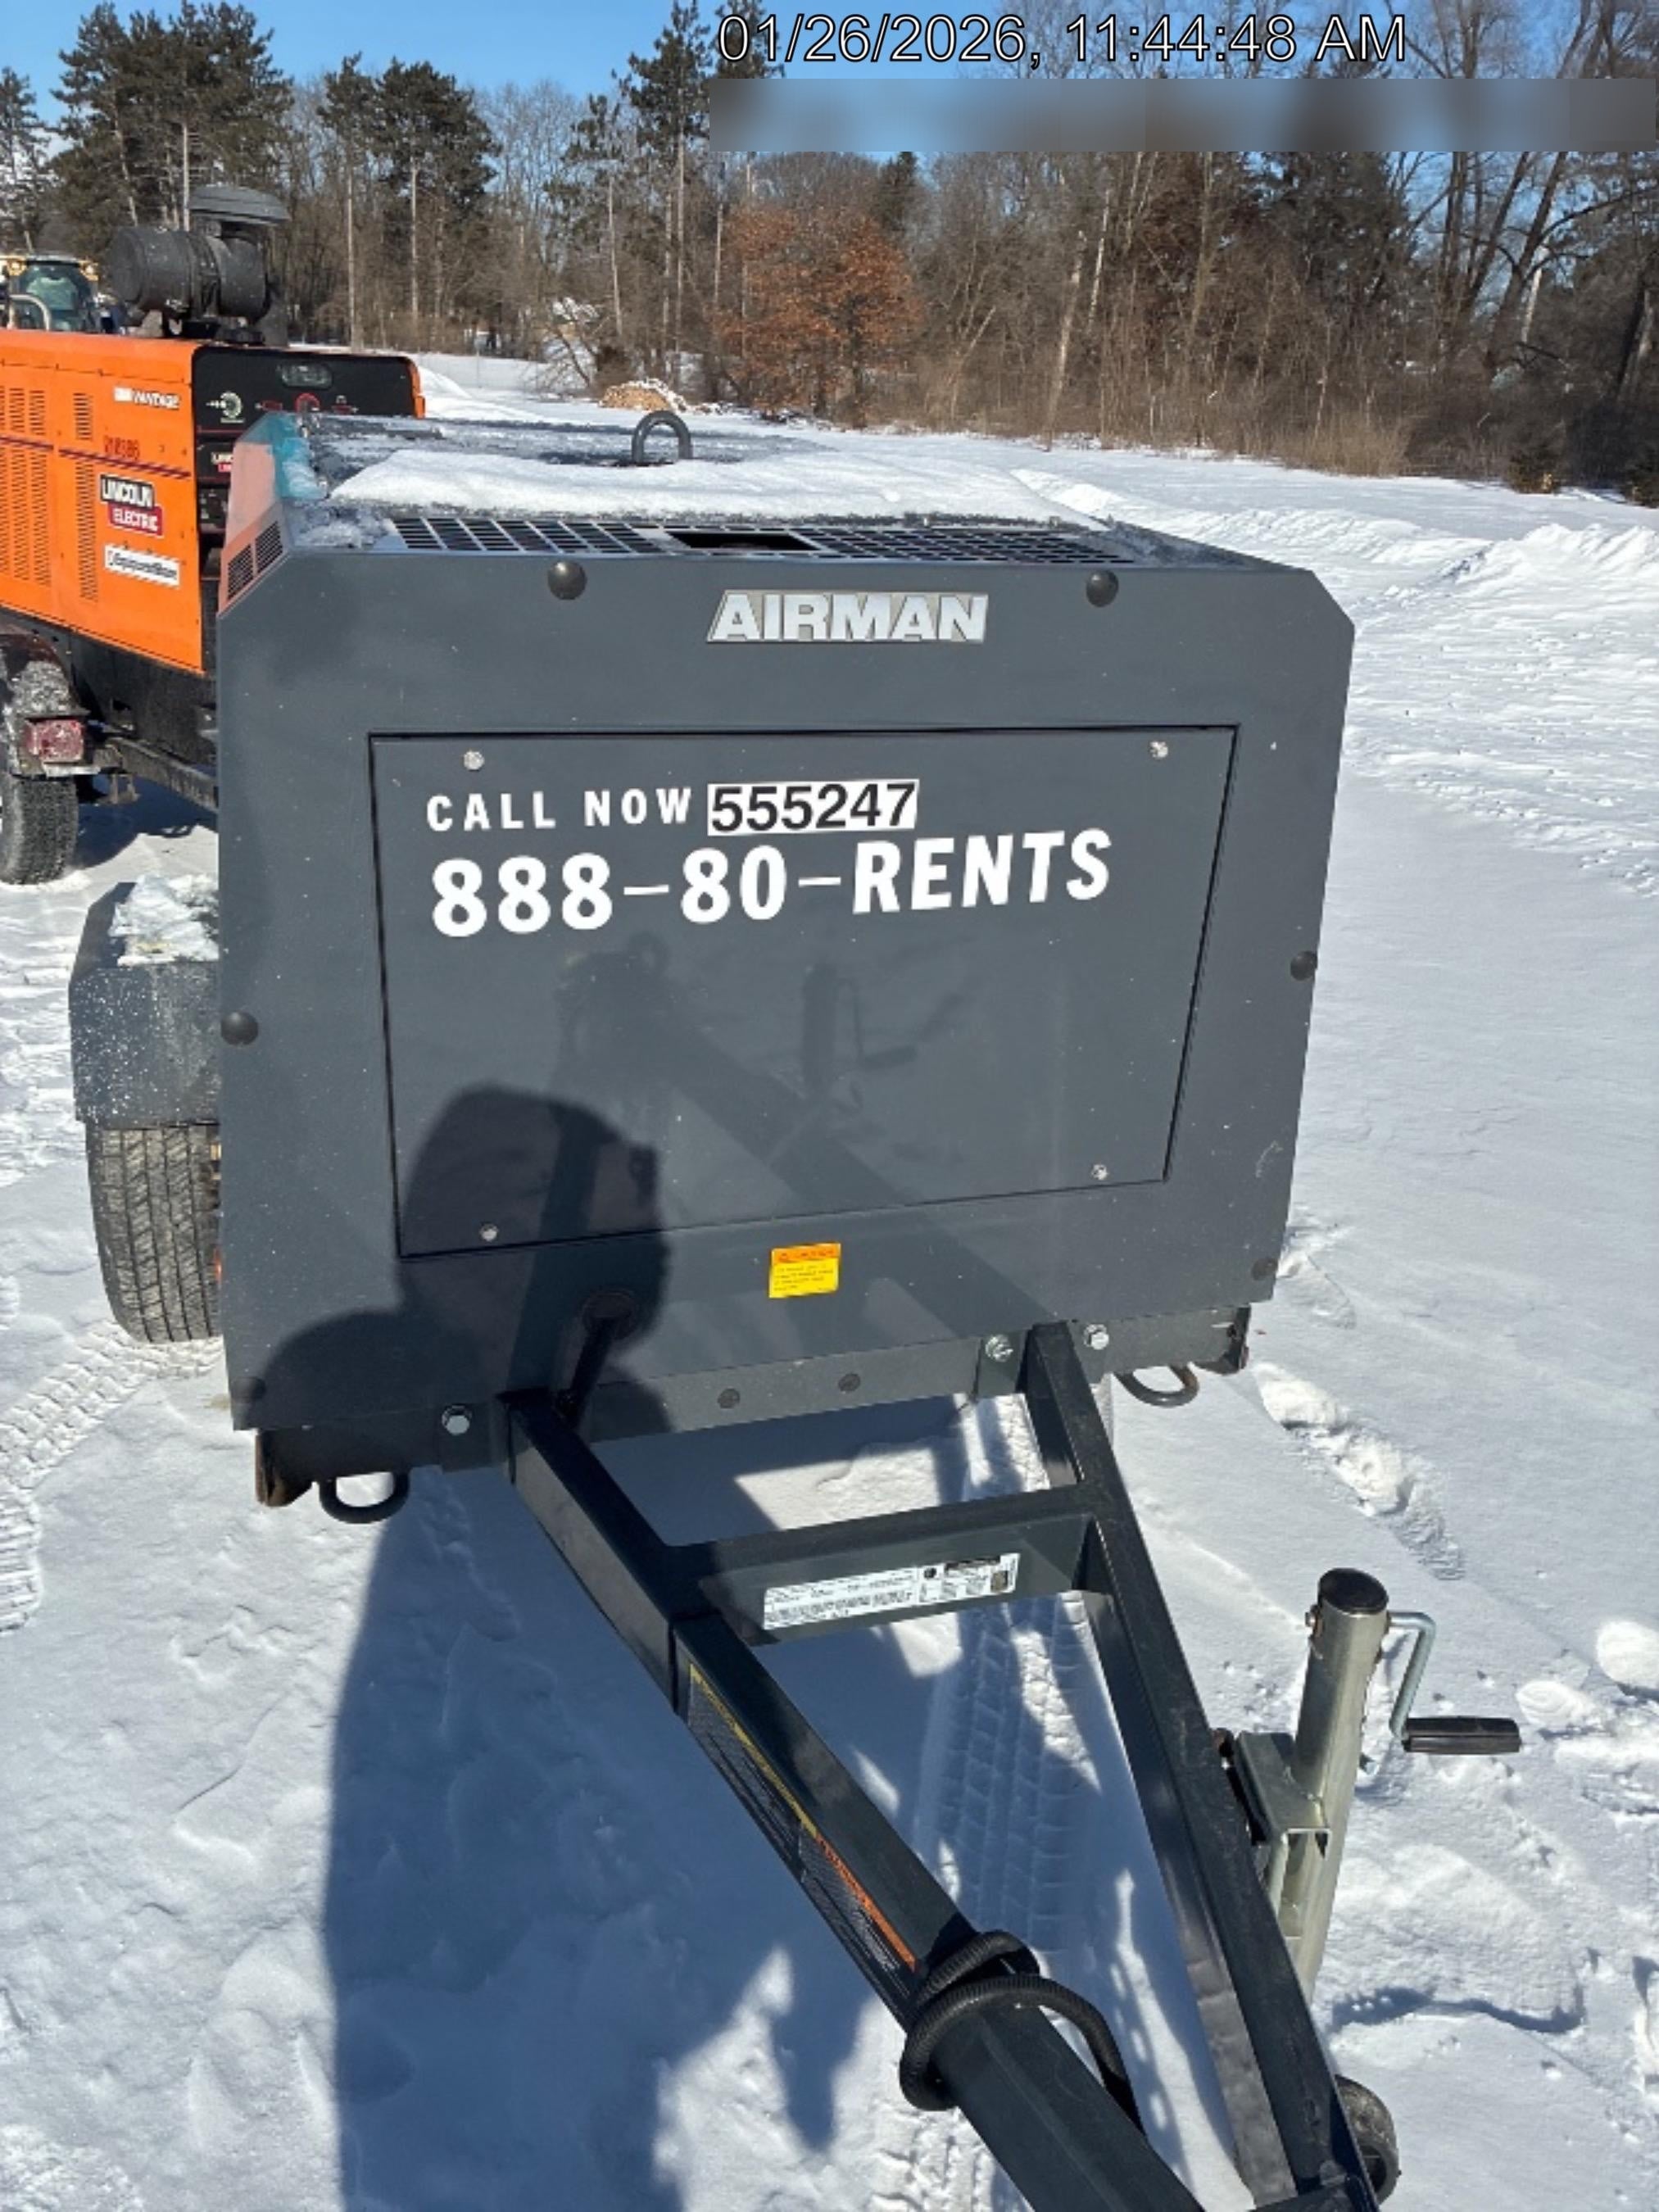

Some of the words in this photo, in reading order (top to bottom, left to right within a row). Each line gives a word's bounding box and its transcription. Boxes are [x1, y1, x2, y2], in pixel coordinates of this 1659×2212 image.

[102, 478, 154, 508] LINCOLN
[112, 508, 159, 532] ELECTRIC
[708, 592, 988, 642] AIRMAN
[426, 791, 555, 832] CALL
[584, 787, 691, 826] NOW
[711, 782, 916, 833] 555247
[432, 827, 1112, 938] 888-80-RENTS
